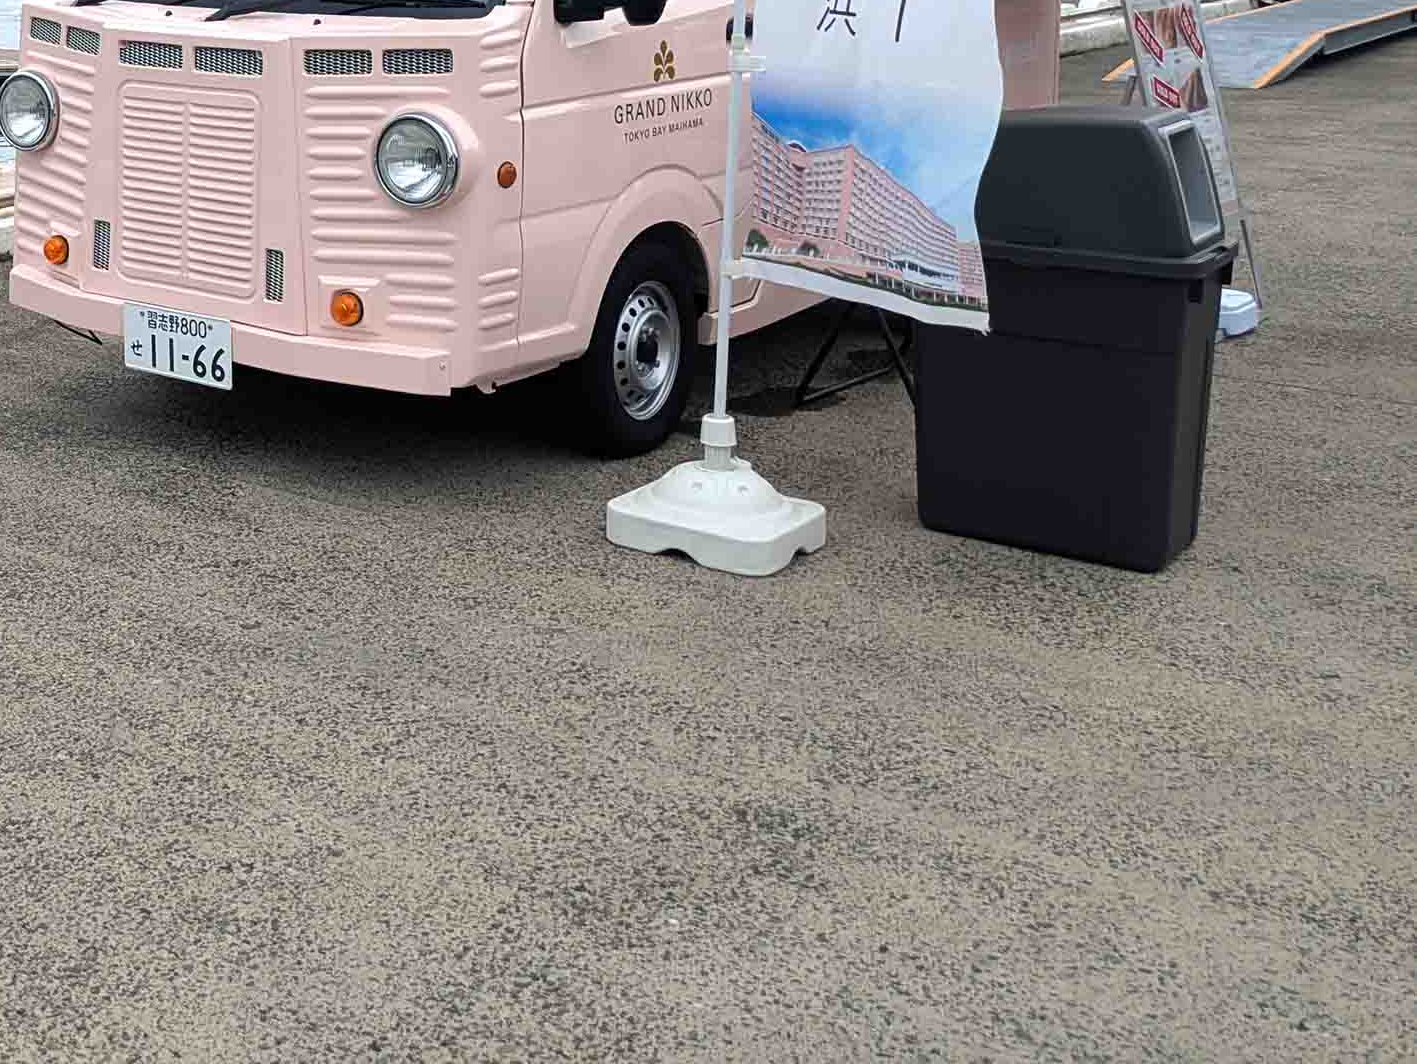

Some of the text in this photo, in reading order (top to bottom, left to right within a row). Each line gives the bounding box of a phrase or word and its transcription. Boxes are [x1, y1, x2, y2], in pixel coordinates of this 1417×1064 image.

[614, 88, 713, 125] GRAND NIKKO
[624, 117, 704, 144] TOKYO BAY MAIHAMA
[131, 334, 226, 383] せ 11-66
